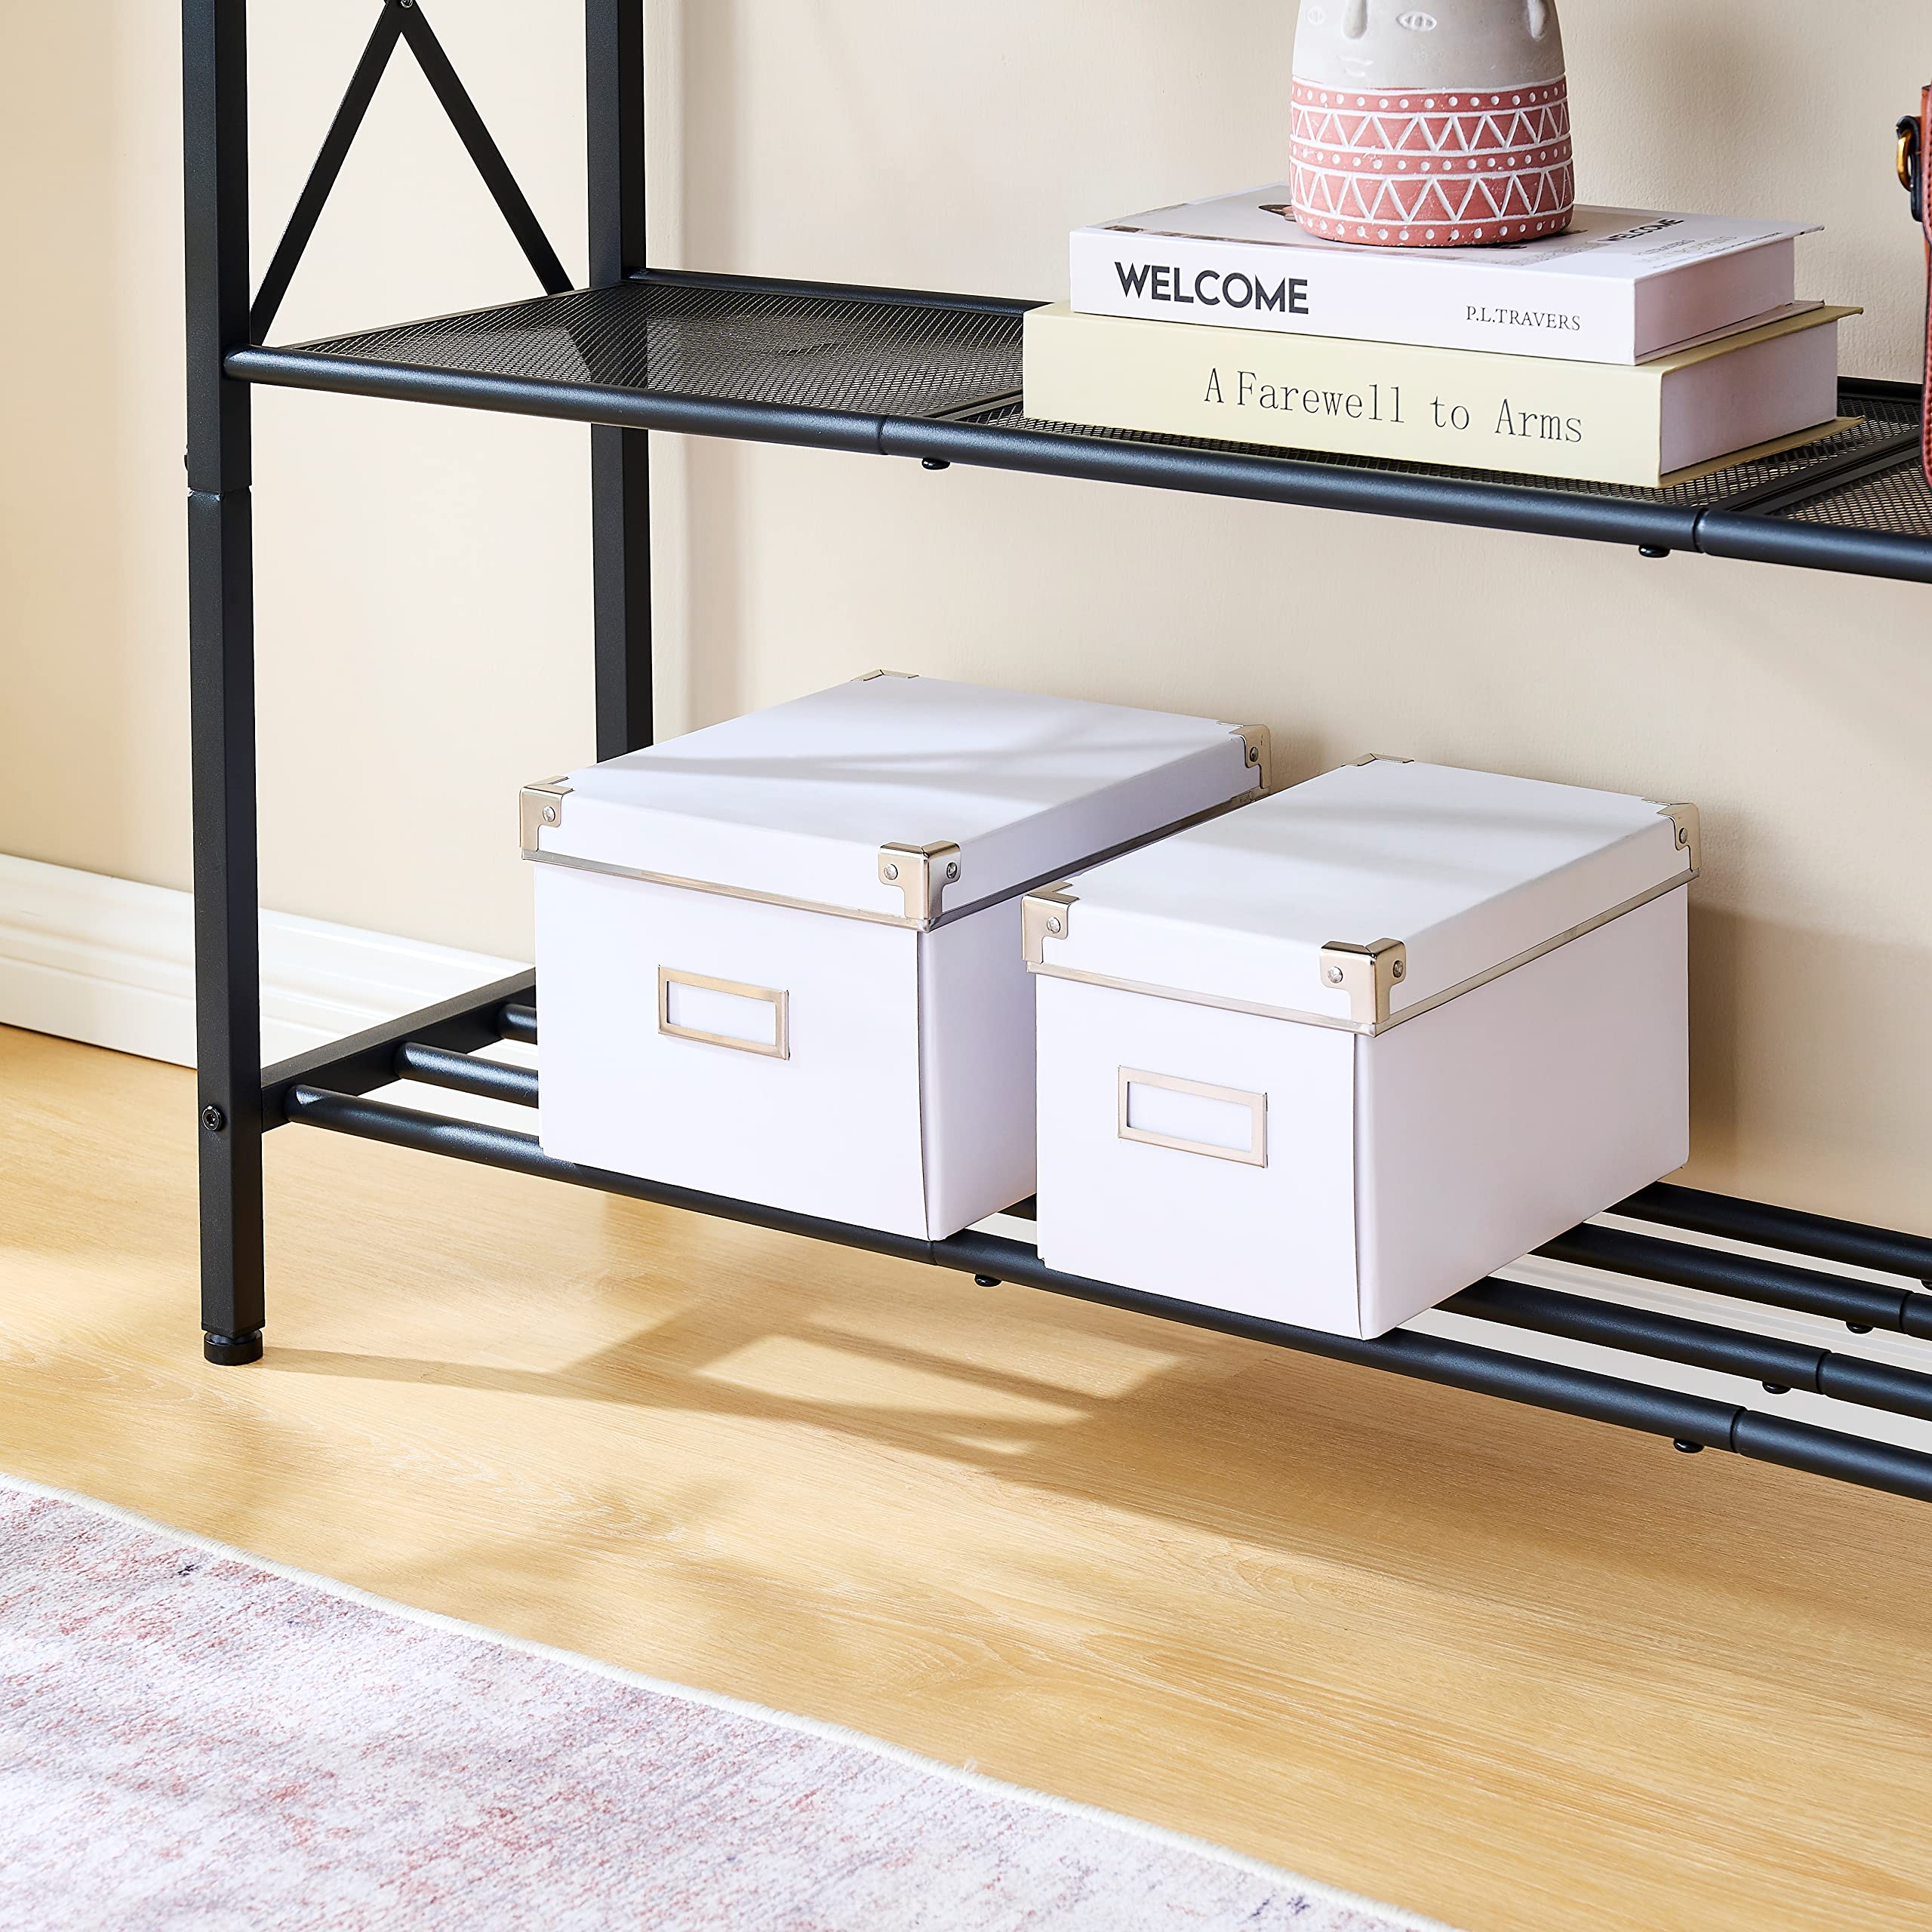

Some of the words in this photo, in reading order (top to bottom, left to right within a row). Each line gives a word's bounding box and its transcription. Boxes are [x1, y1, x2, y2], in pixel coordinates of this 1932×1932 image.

[1597, 219, 1685, 242] WELCOME
[1114, 261, 1309, 315] WELCOME
[1466, 305, 1581, 331] P.L.TRAVERS
[1204, 368, 1225, 404] A
[1236, 371, 1404, 423] Farewell
[1429, 395, 1469, 430] to
[1494, 398, 1583, 443] Arms
